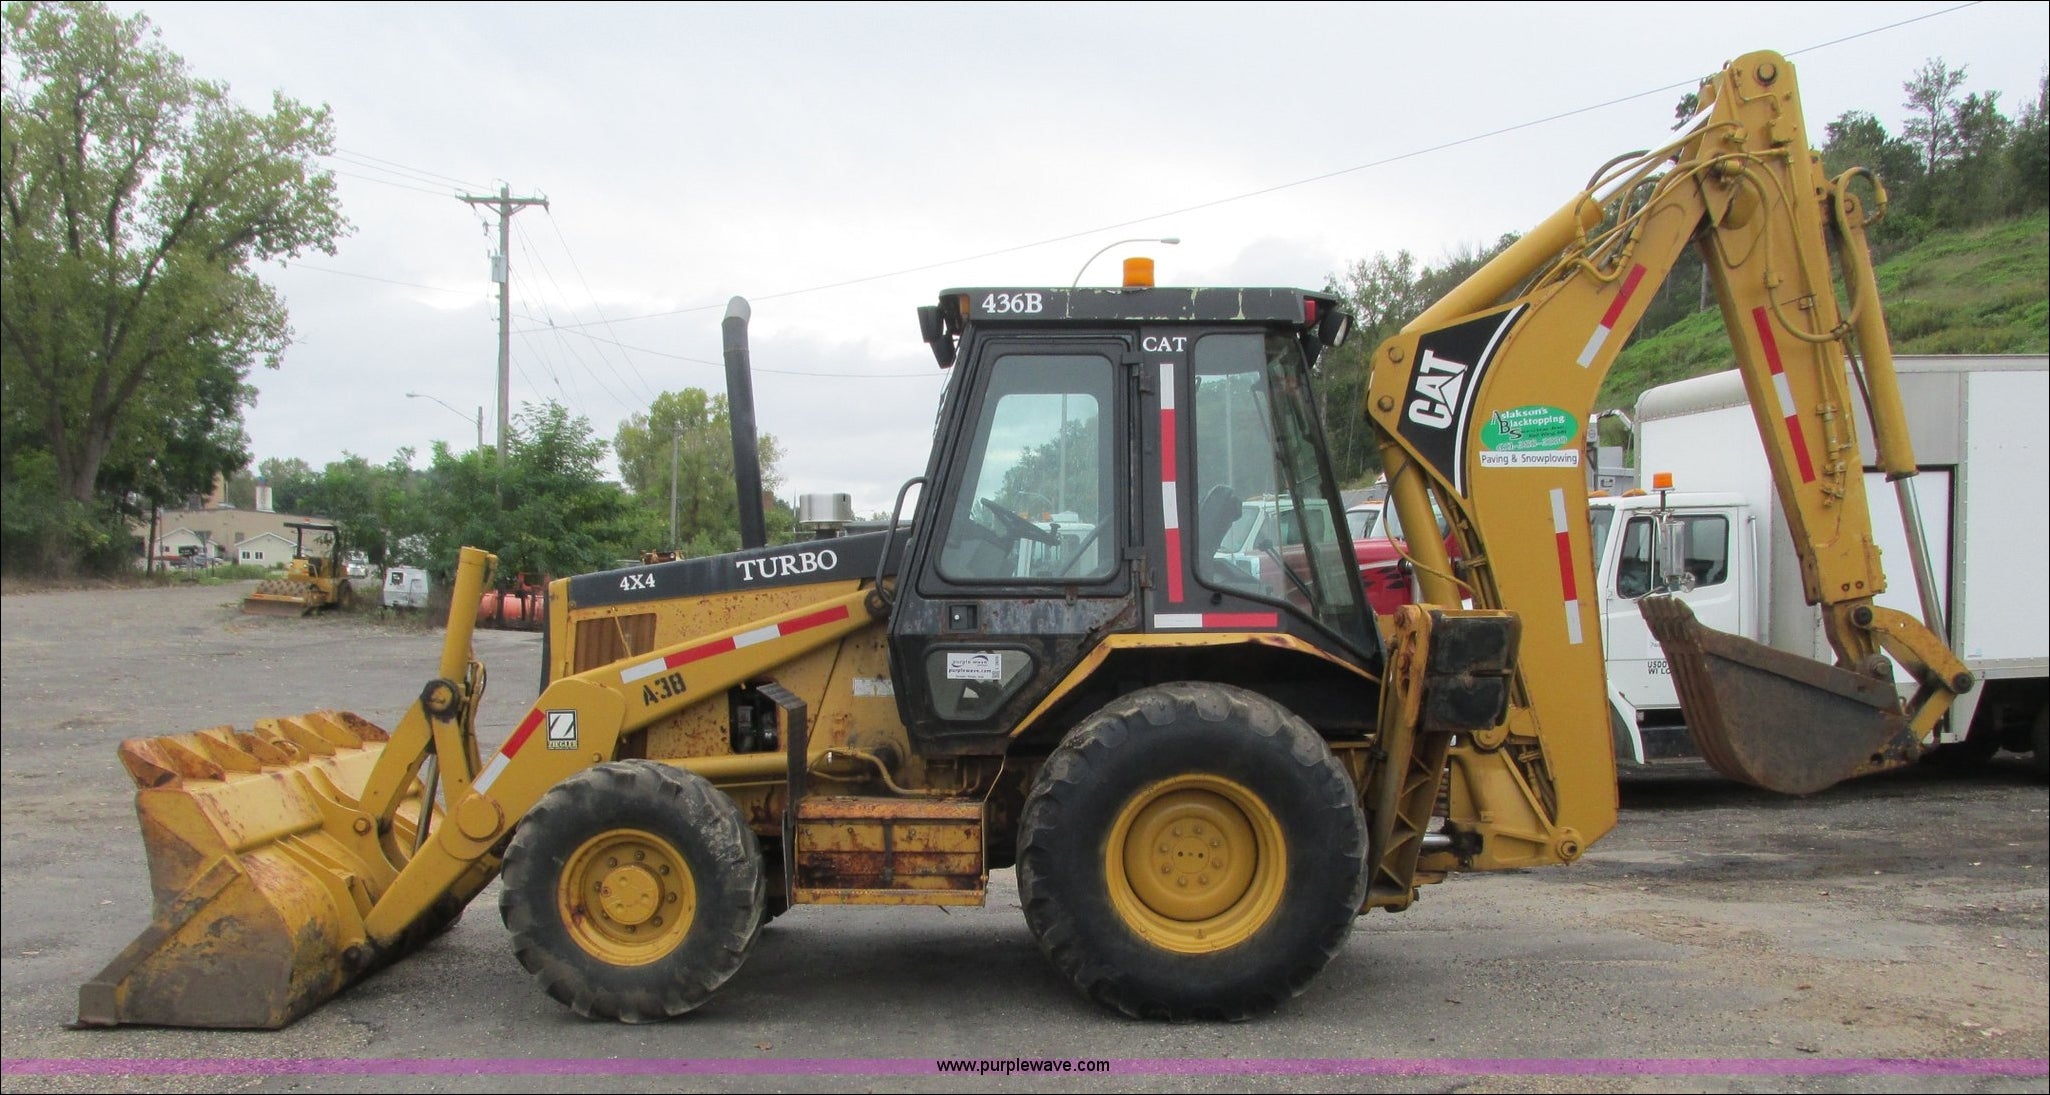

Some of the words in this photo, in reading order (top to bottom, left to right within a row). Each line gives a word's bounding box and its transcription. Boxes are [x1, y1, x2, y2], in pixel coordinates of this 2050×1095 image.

[981, 293, 1043, 313] 436B
[1142, 337, 1187, 352] CAT
[1408, 349, 1468, 429] CAT
[1499, 415, 1565, 434] Blacktopping
[1481, 455, 1509, 465] Paving
[1511, 454, 1518, 463] &
[1522, 453, 1577, 465] Snowplowing
[736, 550, 838, 581] TURBO
[619, 573, 656, 591] 4X4
